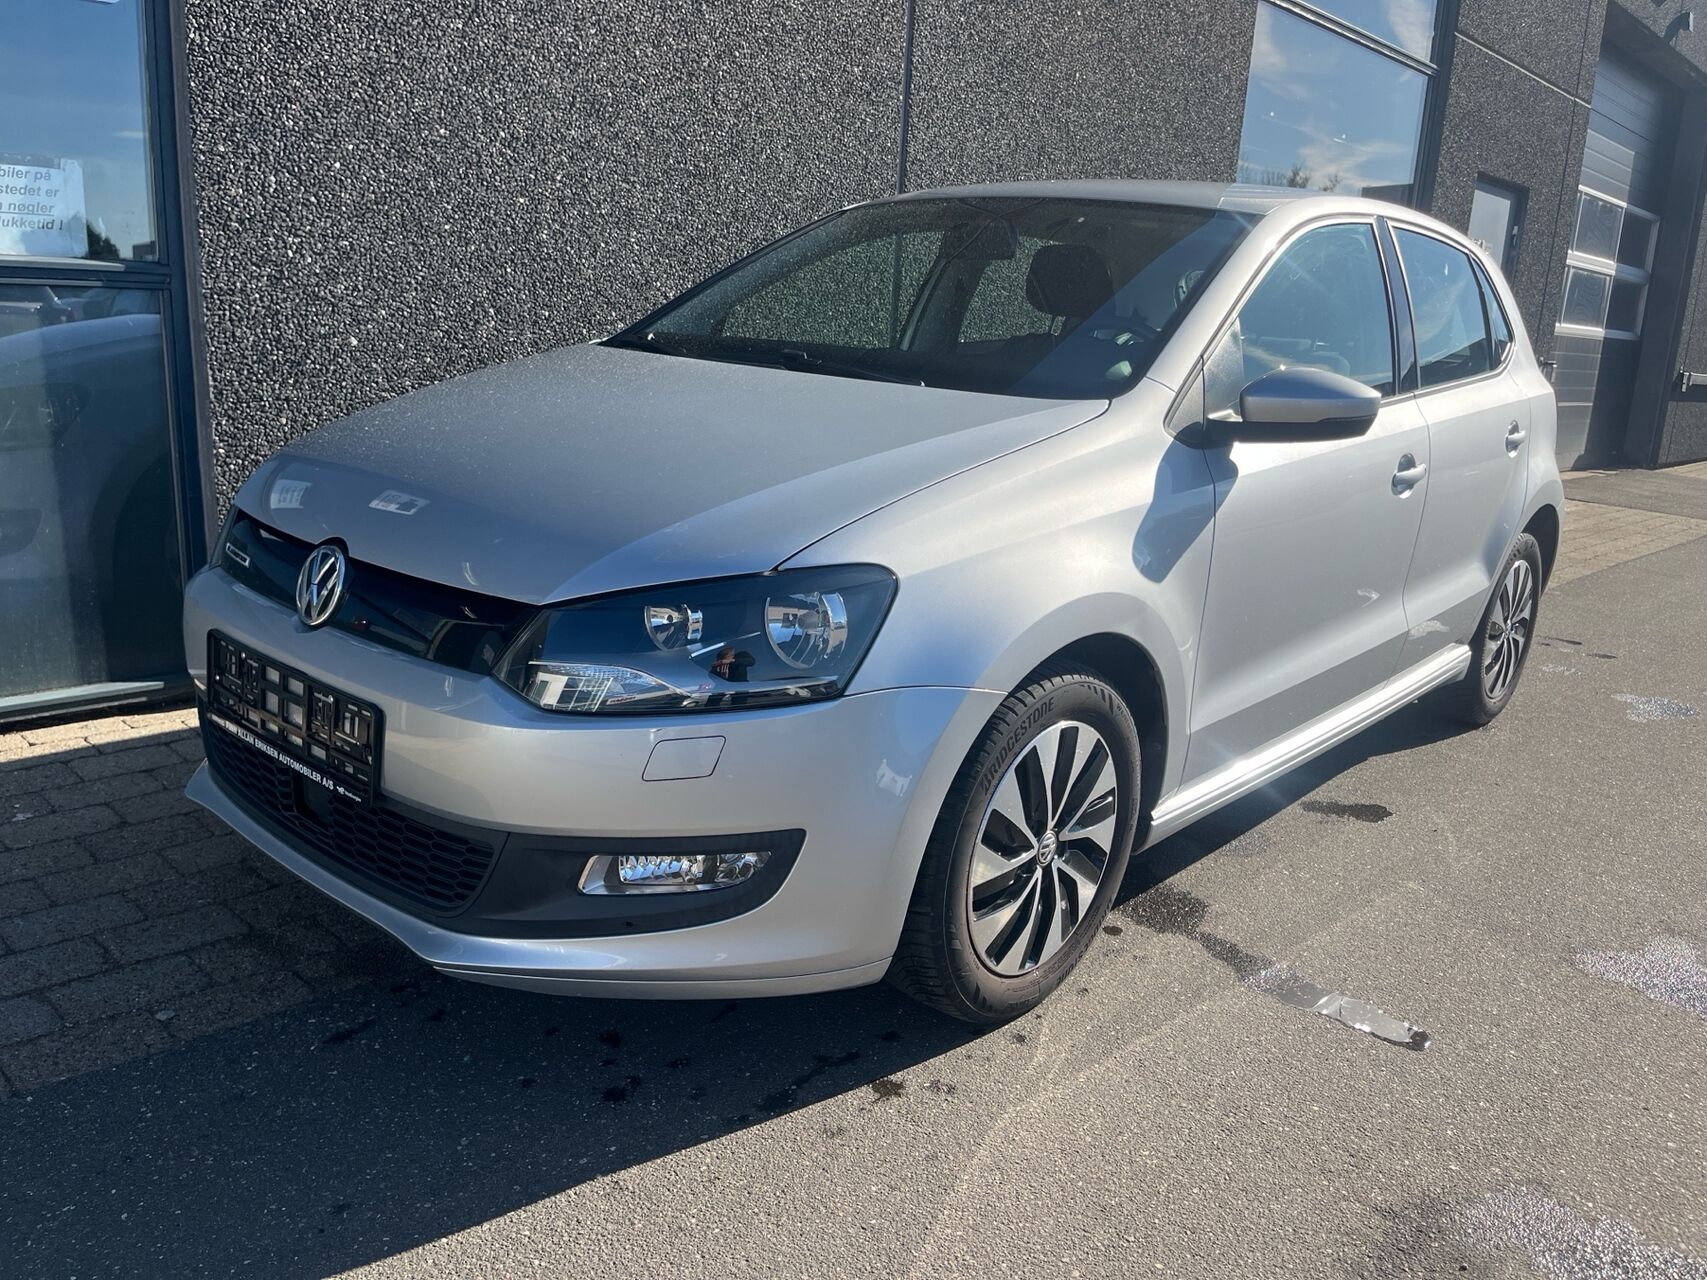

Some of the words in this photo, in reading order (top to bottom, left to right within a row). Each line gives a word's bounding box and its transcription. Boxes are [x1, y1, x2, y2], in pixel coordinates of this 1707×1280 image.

[34, 169, 51, 183] på
[45, 189, 60, 198] er
[8, 202, 55, 215] nøgler
[0, 216, 55, 230] ukketid
[980, 696, 1055, 796] BRIDGESTONE
[254, 738, 279, 760] ERIKSEN
[279, 753, 321, 784] AUTOMOBILER
[322, 776, 334, 790] A/S
